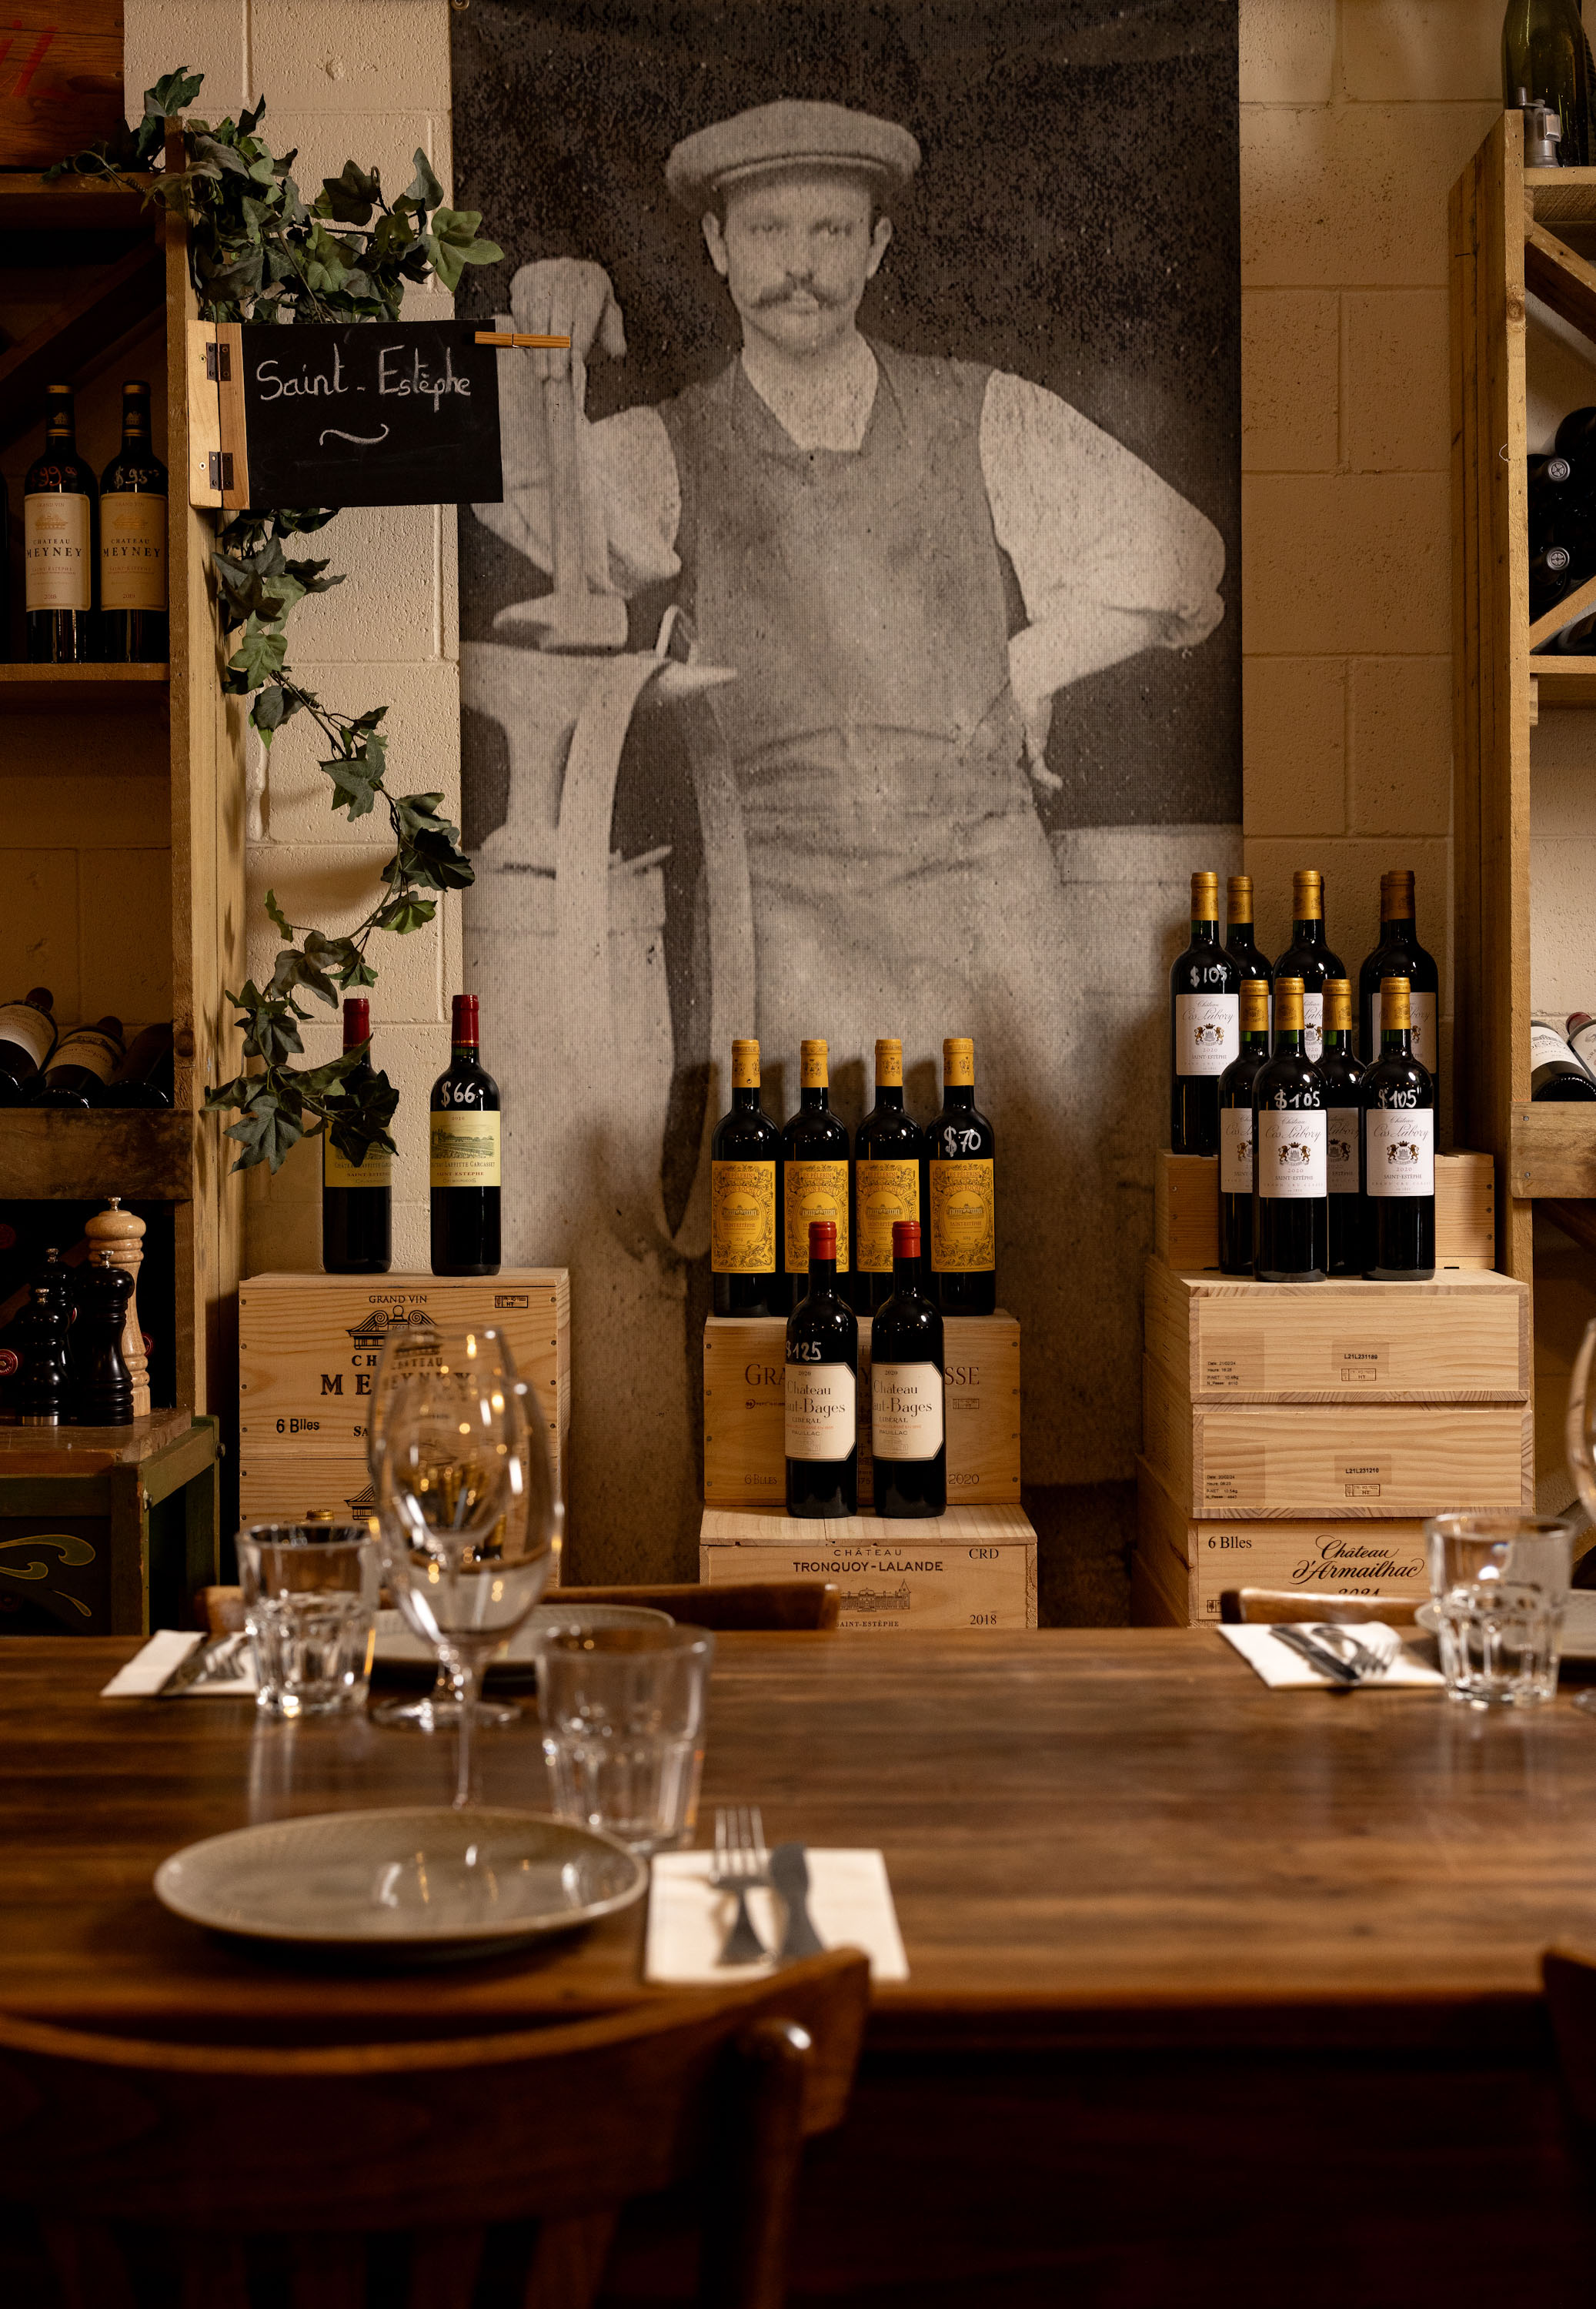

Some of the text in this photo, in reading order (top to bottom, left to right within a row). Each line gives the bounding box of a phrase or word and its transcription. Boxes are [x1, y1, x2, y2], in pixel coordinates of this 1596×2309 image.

[27, 547, 82, 558] MEYNEY
[103, 546, 161, 557] MEYNEY
[441, 1081, 476, 1108] $66
[1274, 1089, 1321, 1110] $105
[943, 1126, 981, 1157] $70
[369, 1295, 427, 1304] GRAND VIN
[276, 1418, 285, 1433] 6
[744, 1474, 752, 1484] 6
[948, 1473, 980, 1485] 2020
[1208, 1536, 1252, 1549] 6 Blles
[1315, 1535, 1400, 1559] Château
[833, 1547, 902, 1556] CHÂTEAU
[969, 1548, 999, 1559] CRD
[1289, 1558, 1425, 1585] d'Armailhac
[970, 1614, 997, 1626] 2018
